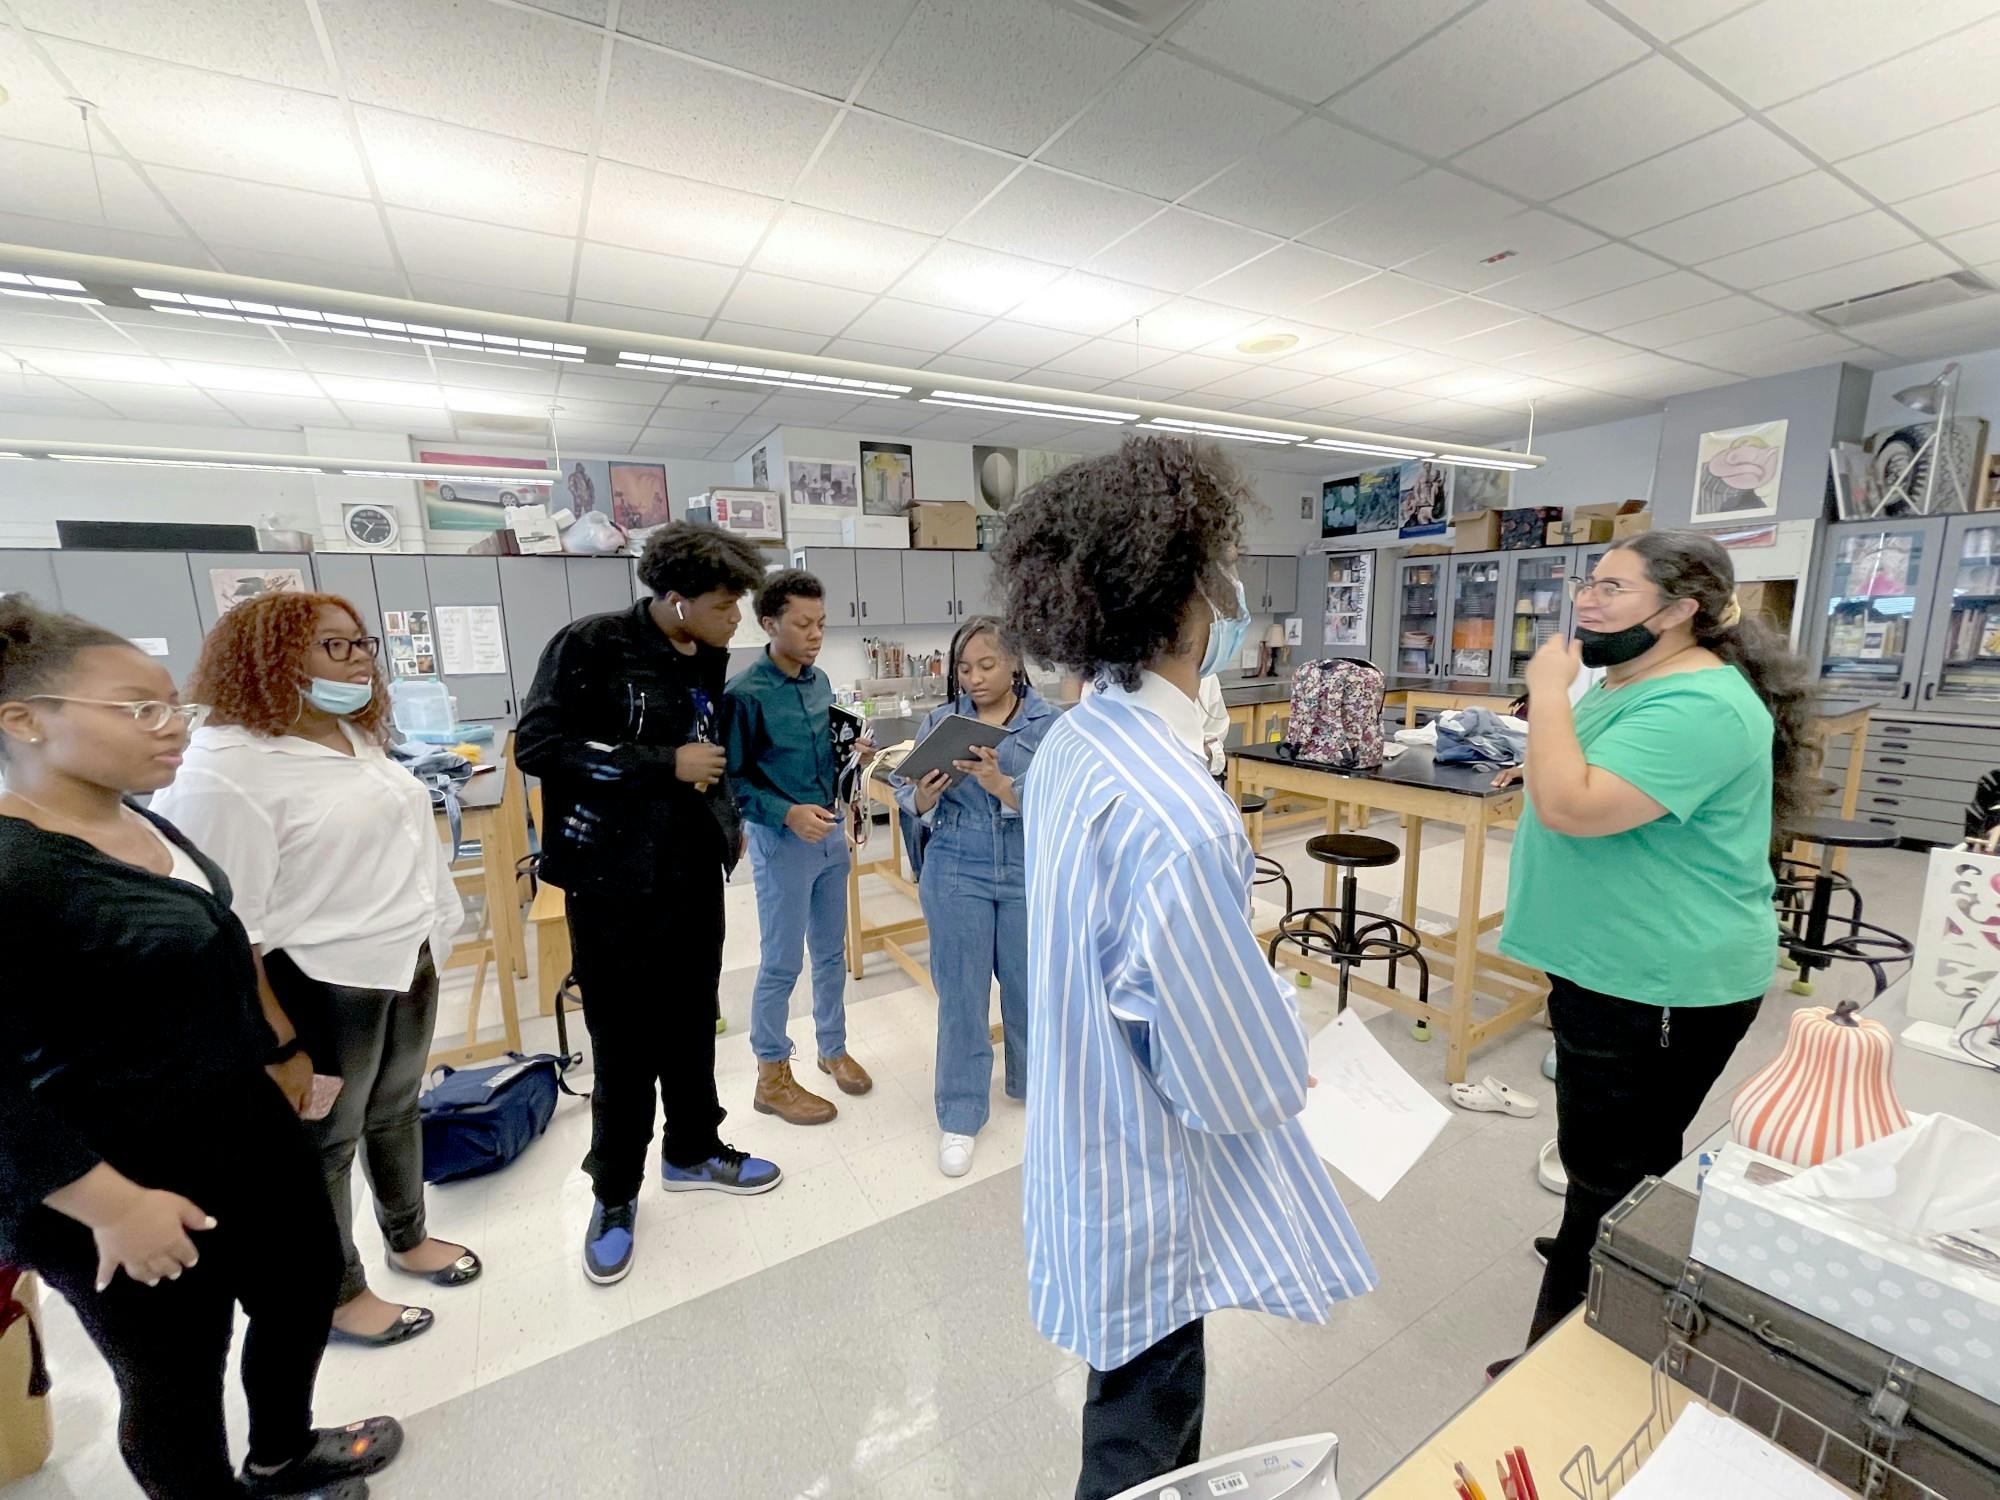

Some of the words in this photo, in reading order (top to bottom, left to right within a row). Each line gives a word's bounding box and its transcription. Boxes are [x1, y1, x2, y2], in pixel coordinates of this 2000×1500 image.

[1359, 560, 1367, 575] AP
[1357, 576, 1366, 605] Studio
[1356, 607, 1364, 621] Art
